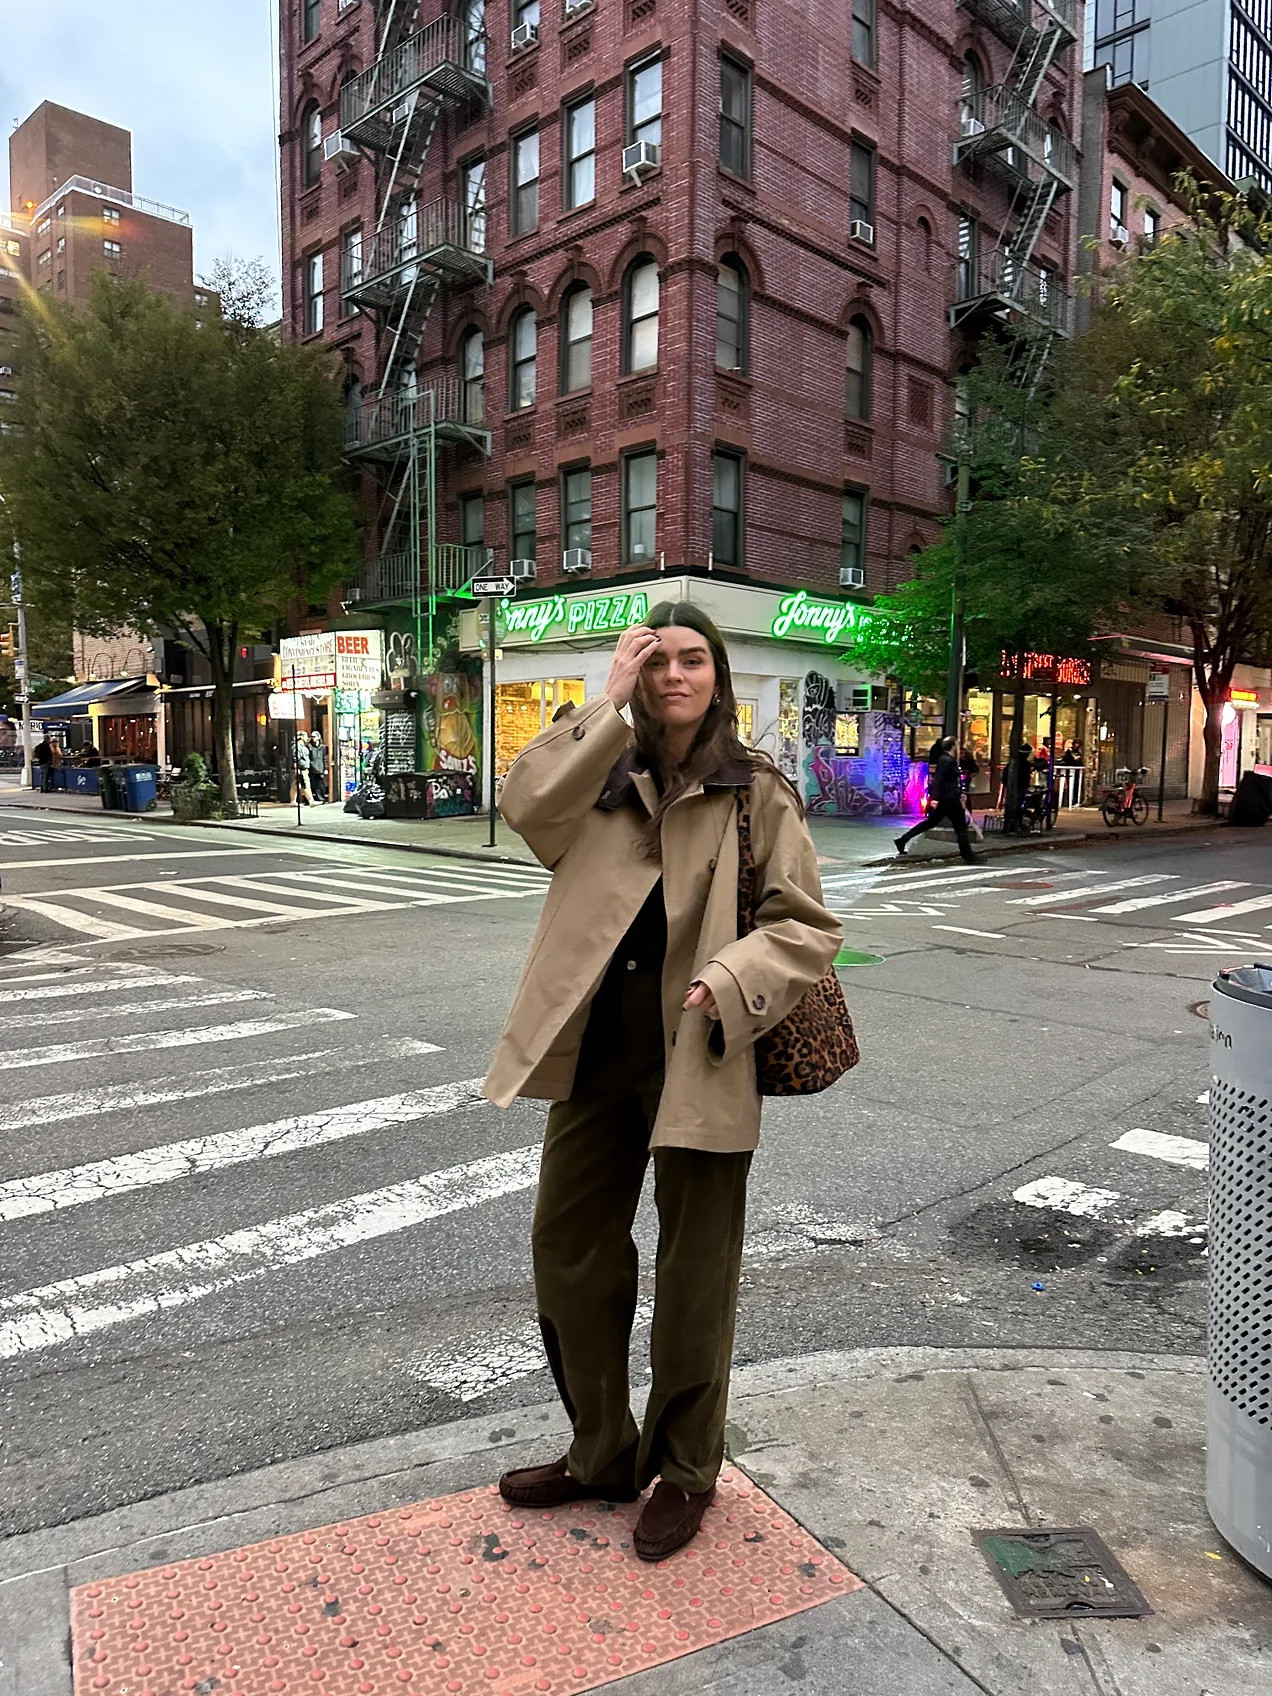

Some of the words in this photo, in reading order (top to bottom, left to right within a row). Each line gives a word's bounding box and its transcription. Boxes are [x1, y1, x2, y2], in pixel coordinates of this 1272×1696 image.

[475, 583, 489, 591] ONE
[495, 582, 510, 591] WAY
[500, 594, 565, 641] nny's
[567, 592, 647, 633] PIZZA
[773, 588, 857, 643] Jonny's
[337, 635, 369, 655] BEER
